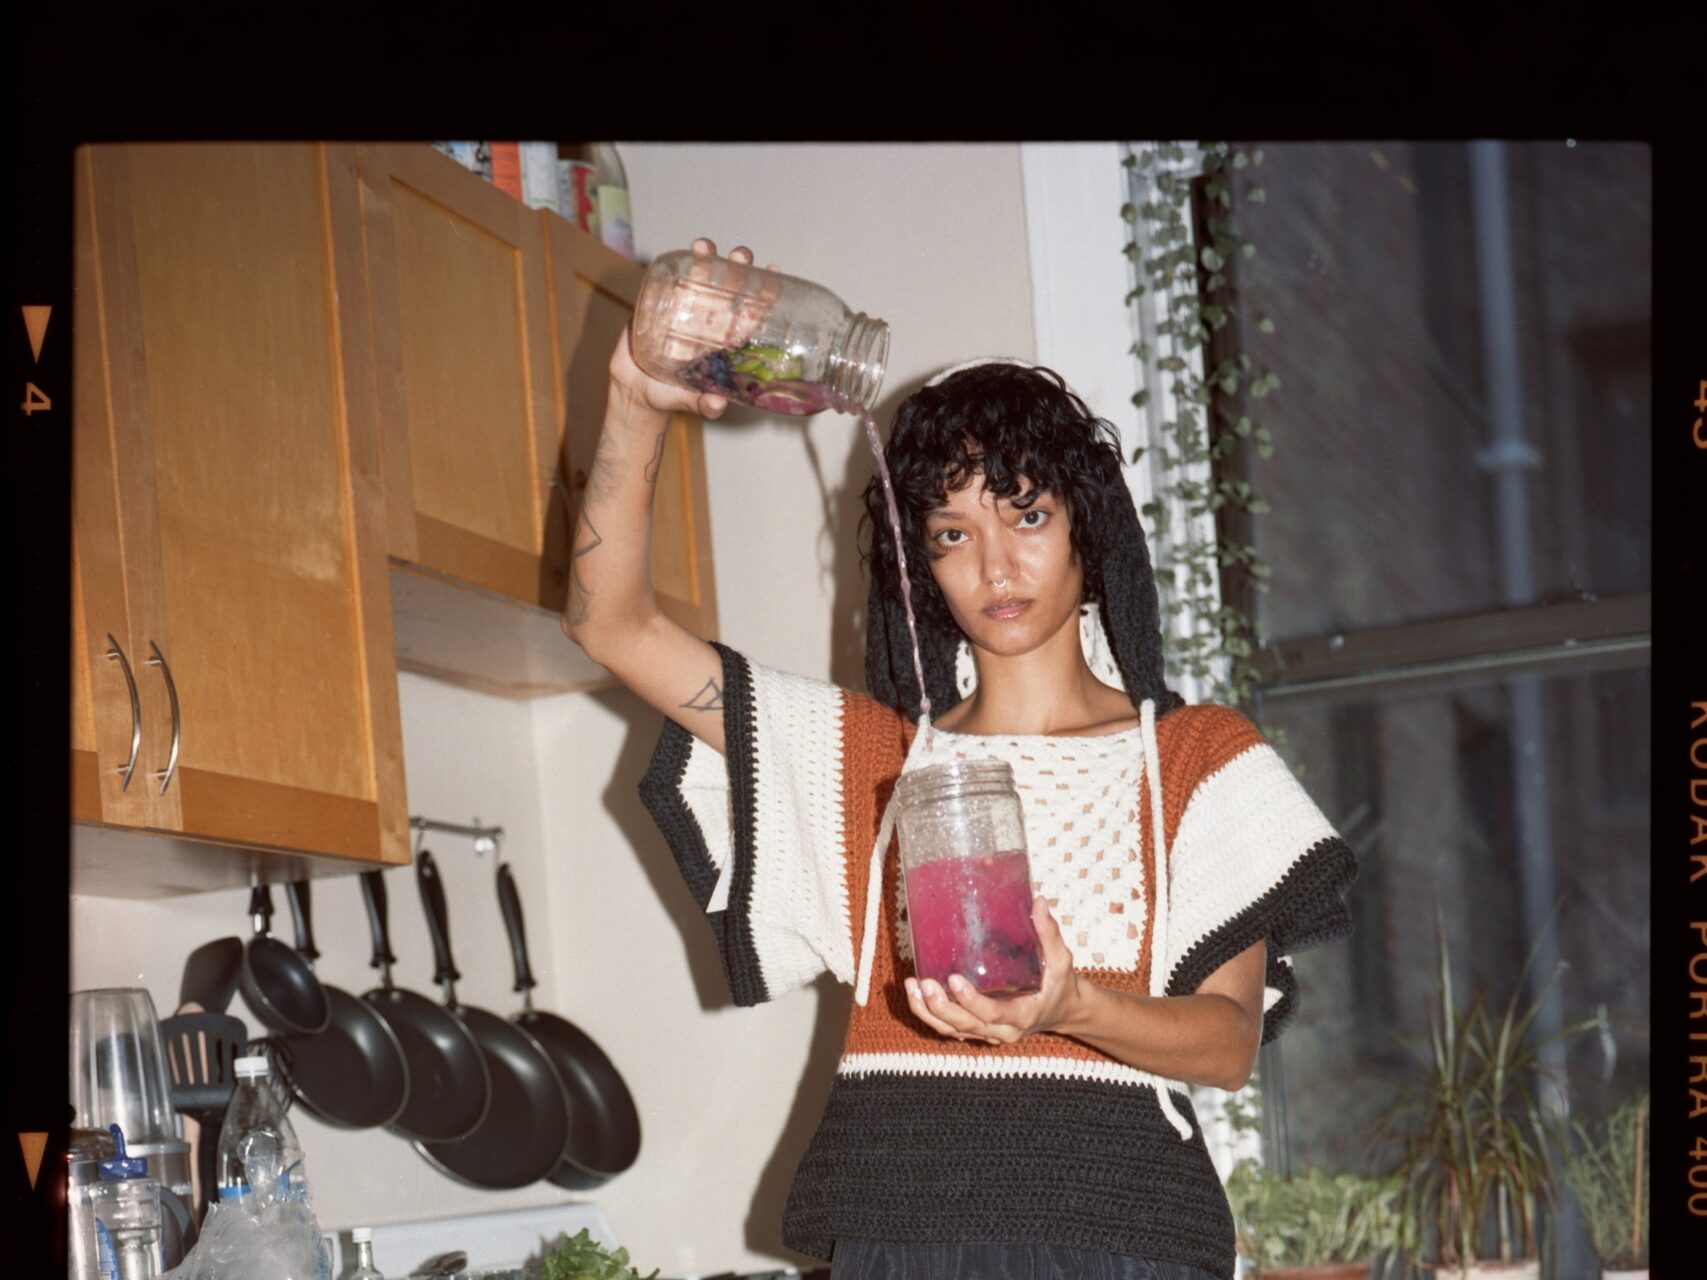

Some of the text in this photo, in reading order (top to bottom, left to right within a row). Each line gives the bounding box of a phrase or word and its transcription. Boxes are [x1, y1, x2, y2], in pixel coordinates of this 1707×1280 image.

[21, 382, 51, 415] 4
[1690, 701, 1707, 881] KODAK
[1688, 1137, 1707, 1216] 400
